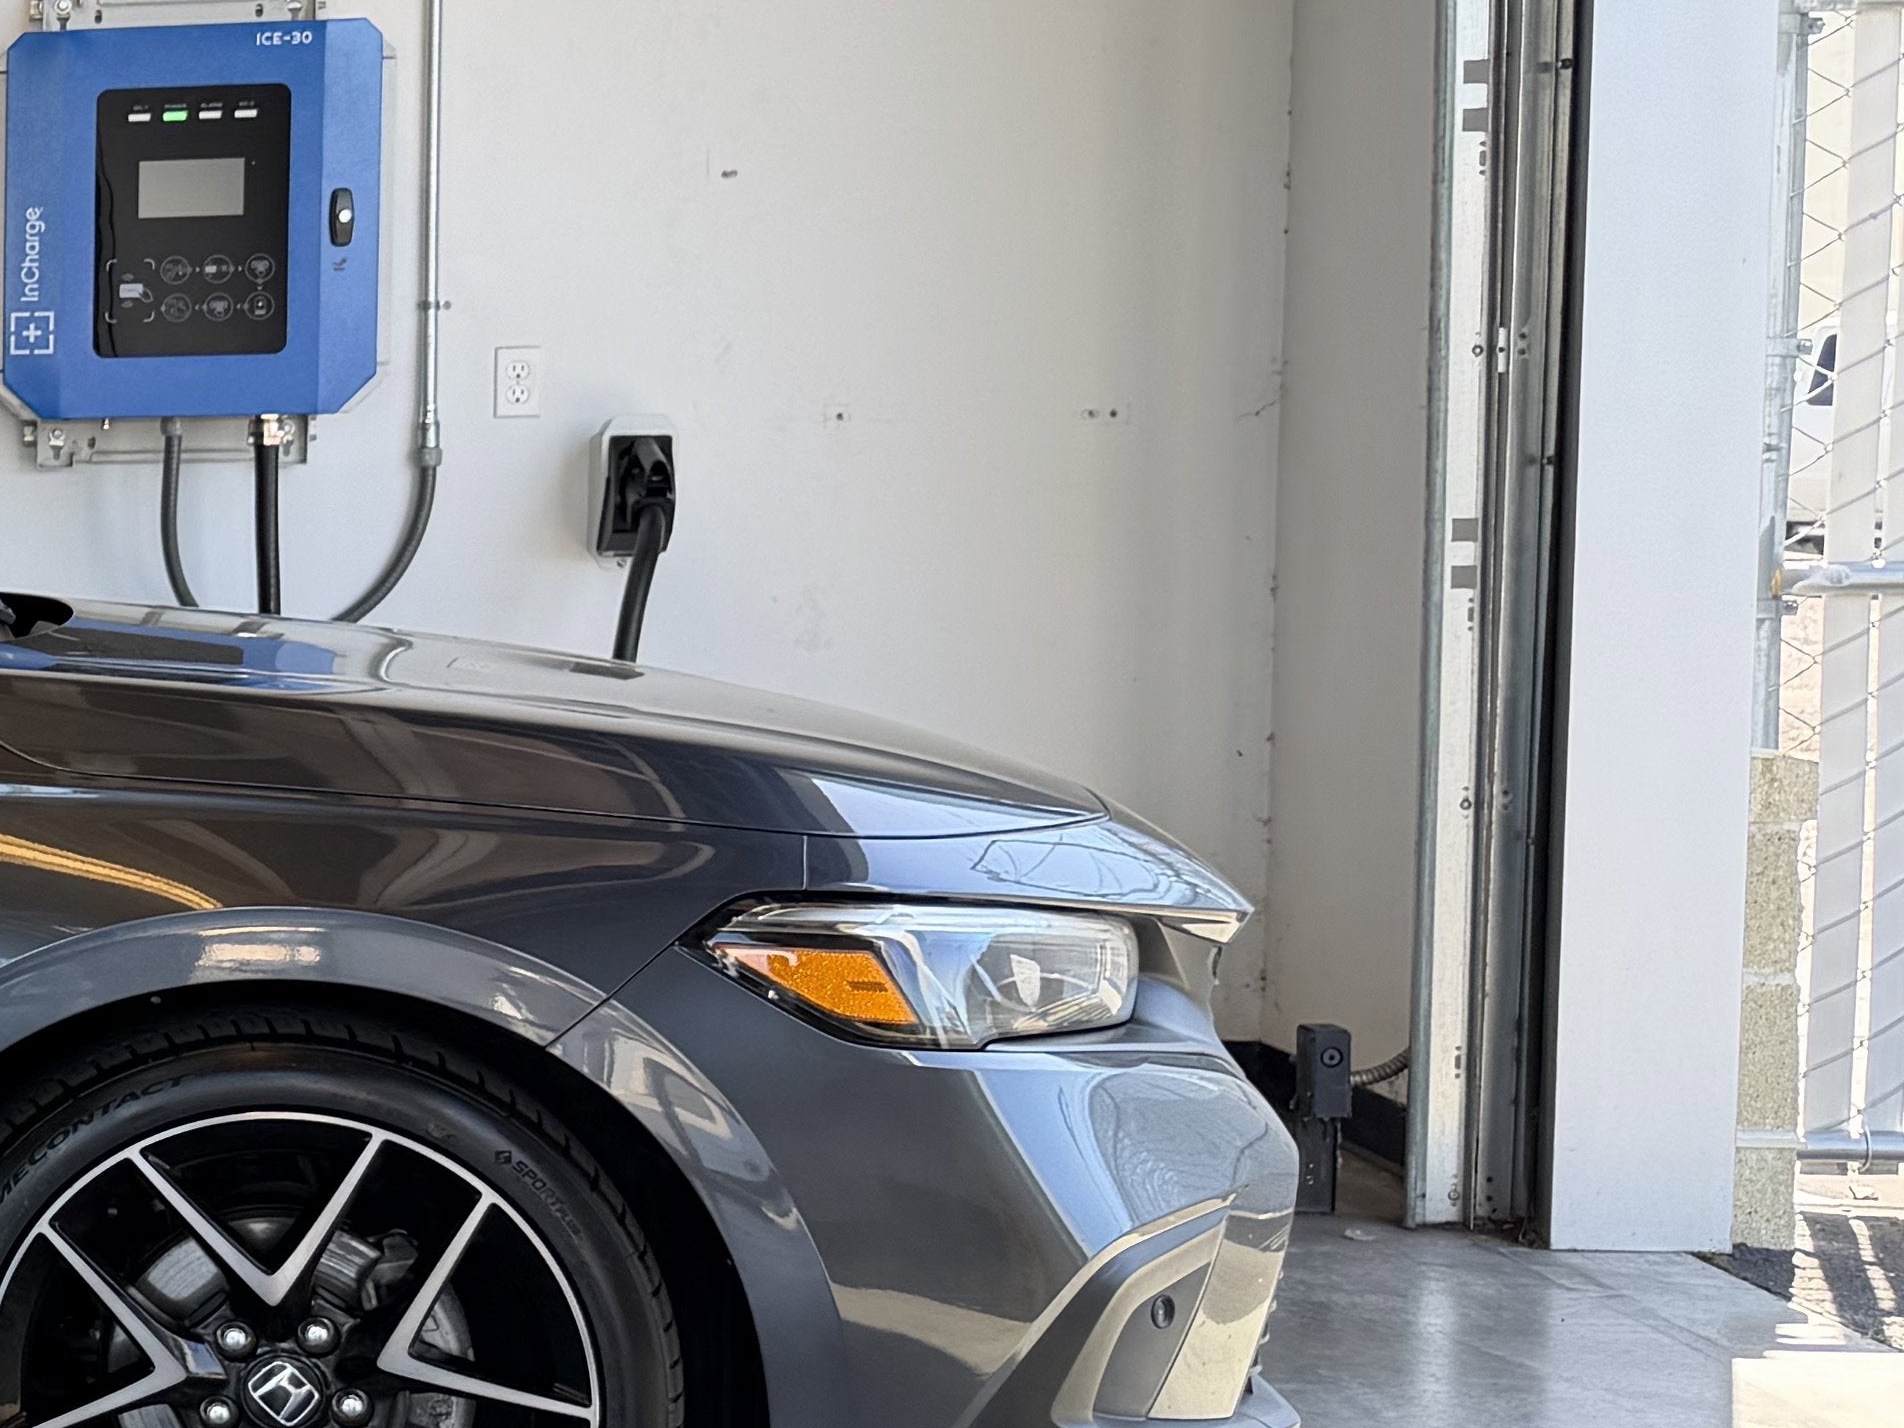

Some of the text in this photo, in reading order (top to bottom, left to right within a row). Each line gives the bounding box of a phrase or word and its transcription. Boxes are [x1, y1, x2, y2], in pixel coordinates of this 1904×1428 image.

[256, 30, 313, 46] ICE-30
[20, 206, 46, 302] InCharge
[511, 1159, 566, 1208] SPORT
